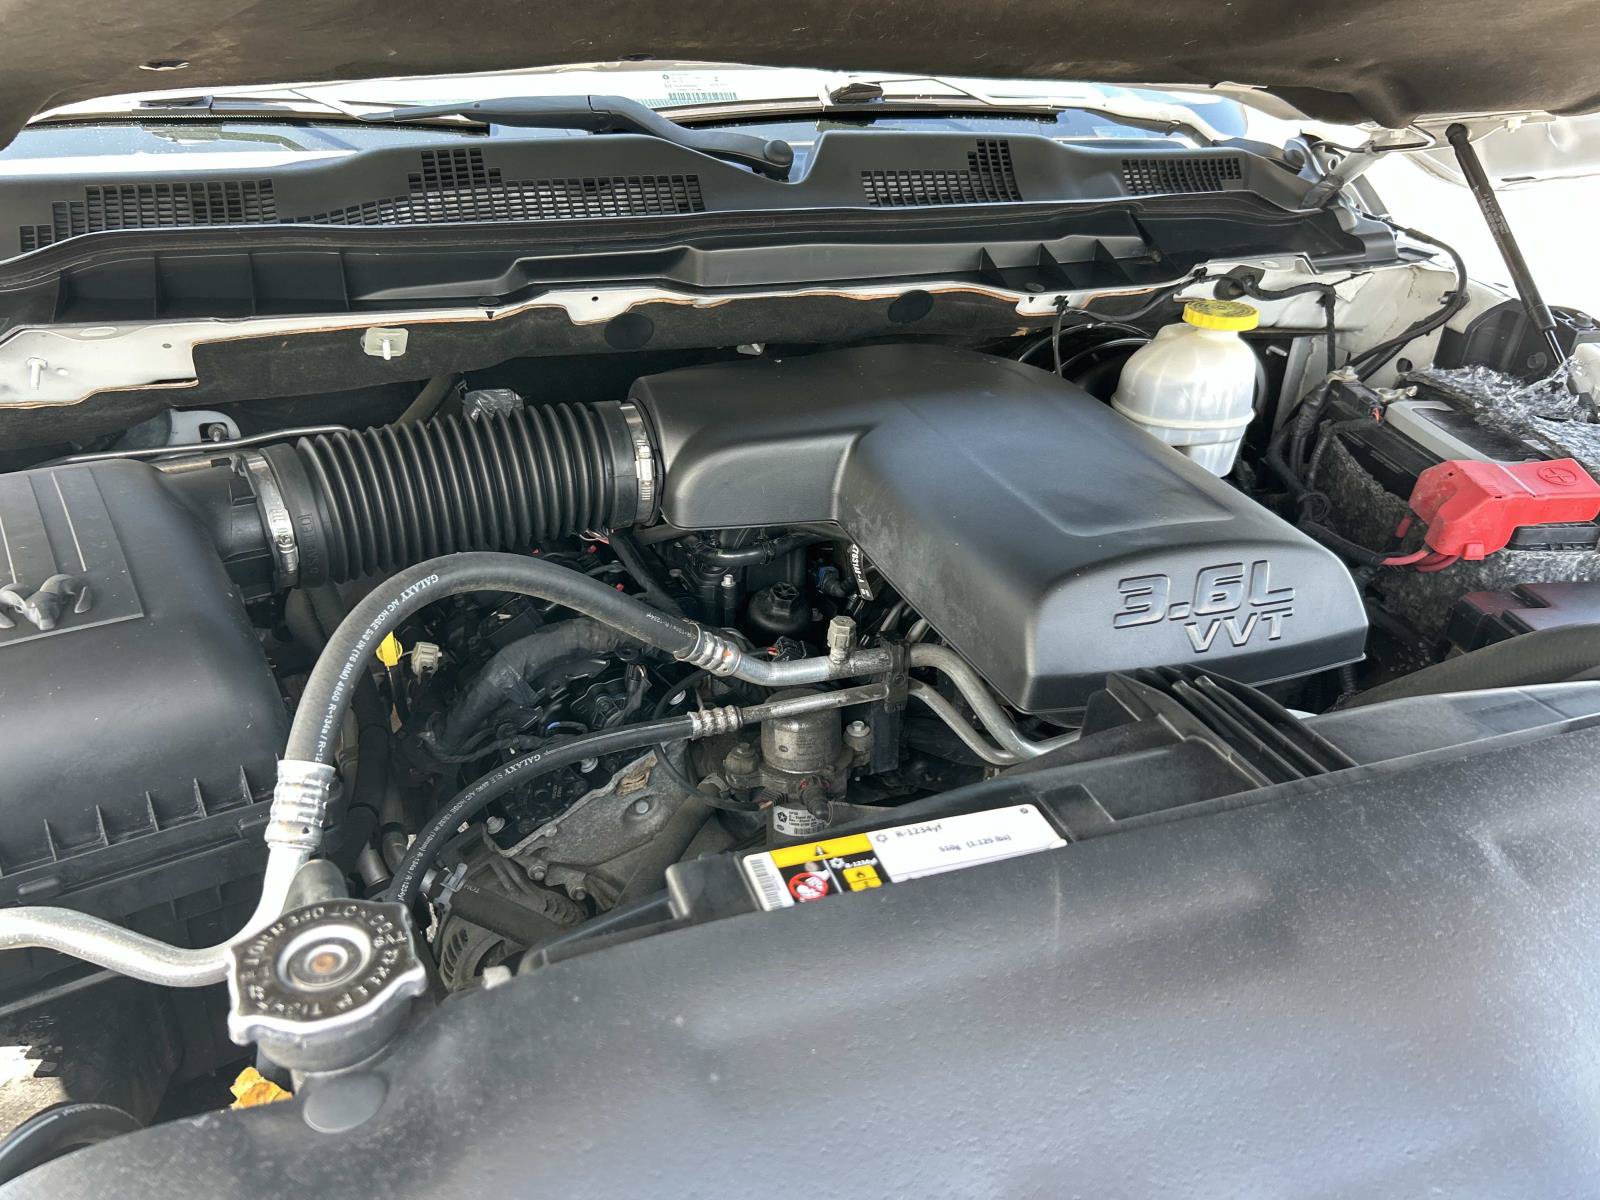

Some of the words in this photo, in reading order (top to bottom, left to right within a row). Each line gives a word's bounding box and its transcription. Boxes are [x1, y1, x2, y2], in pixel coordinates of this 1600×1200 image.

[400, 574, 439, 602] GALAXY
[1113, 559, 1296, 630] 3.6L
[370, 610, 390, 631] HOSE
[1184, 606, 1294, 654] VVT
[355, 639, 367, 651] IN
[339, 662, 355, 680] MM)
[331, 680, 345, 702] 4860
[321, 703, 337, 734] R-134a
[504, 754, 541, 776] GALAXY
[895, 822, 943, 838] R-1234yf
